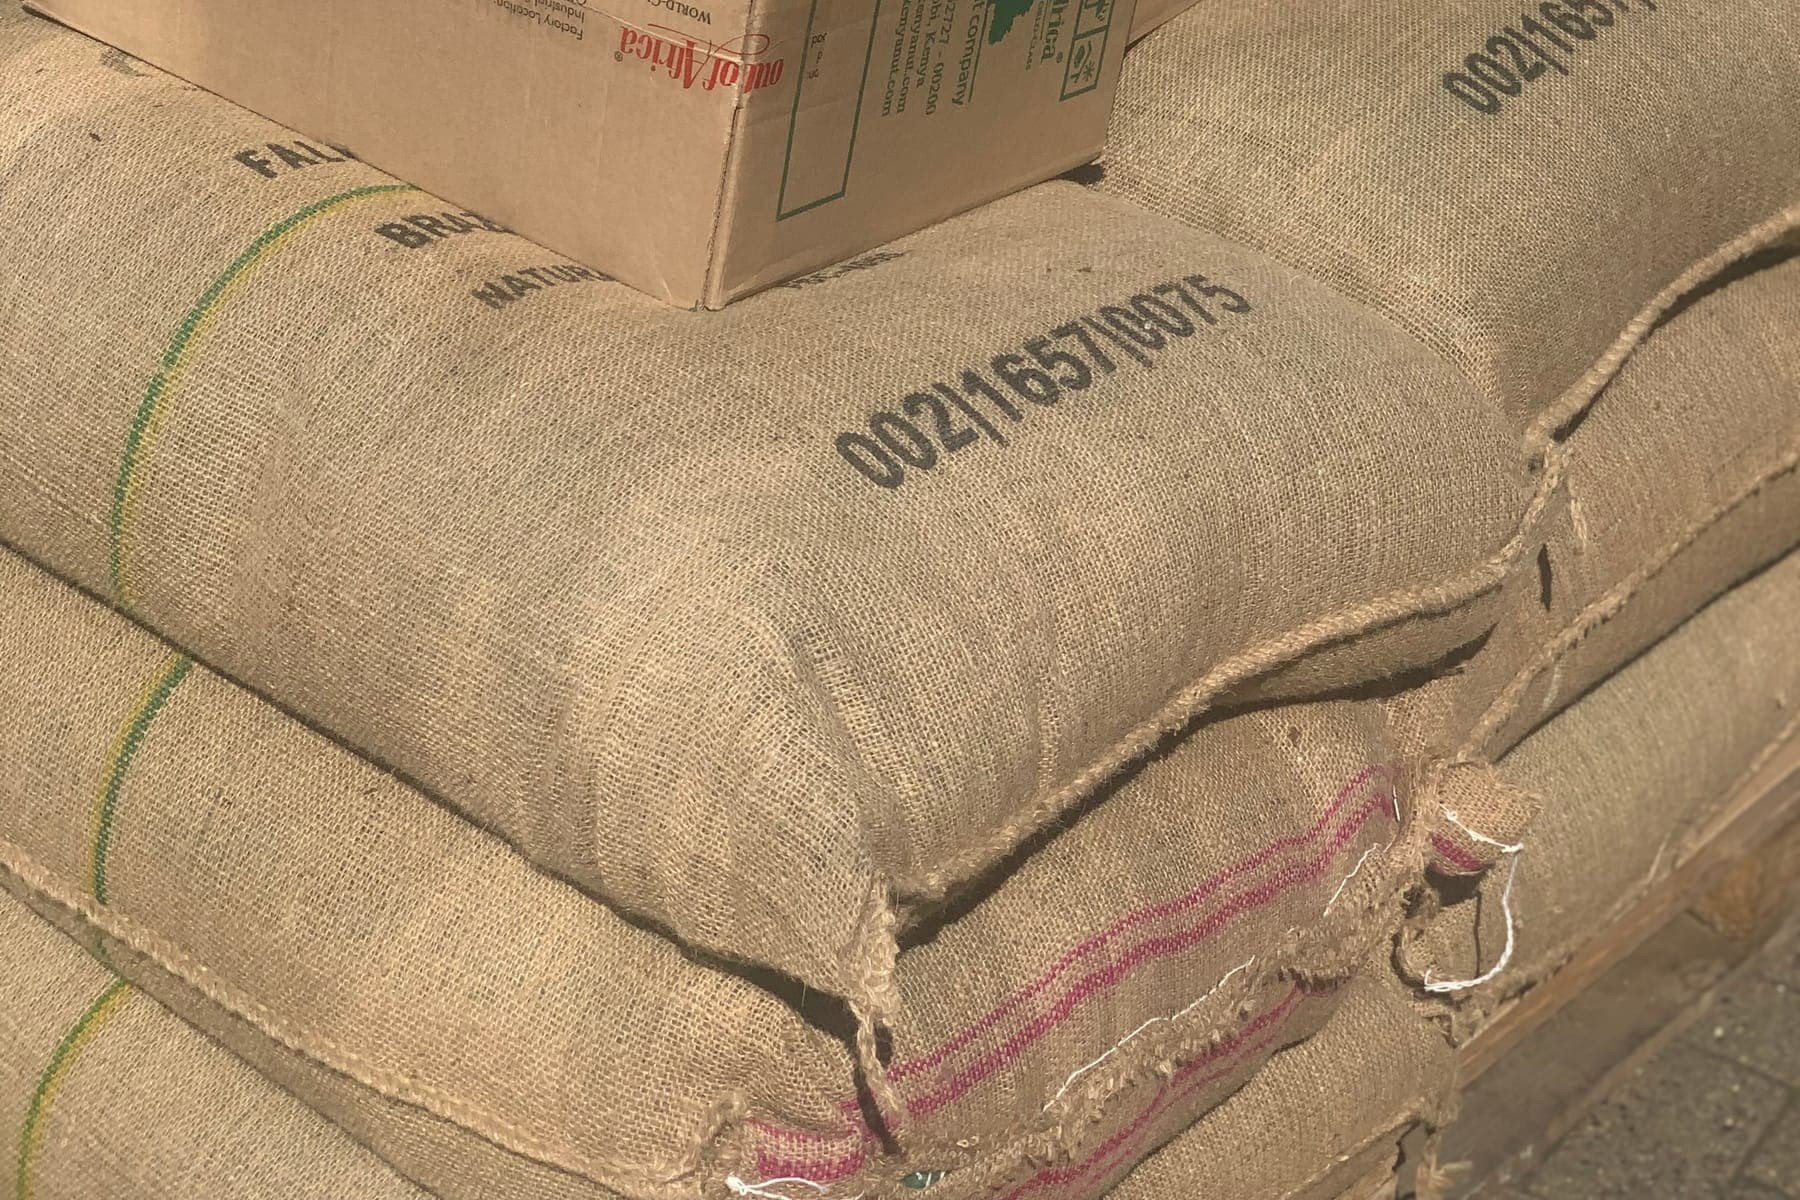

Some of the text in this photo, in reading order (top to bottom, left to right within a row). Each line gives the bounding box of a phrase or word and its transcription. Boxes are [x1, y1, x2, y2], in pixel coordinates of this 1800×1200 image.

[543, 12, 584, 41] Factory
[702, 58, 741, 92] of
[742, 56, 785, 94] out
[915, 30, 937, 88] Kenya
[951, 14, 983, 107] company
[924, 63, 945, 116] 00200
[233, 138, 357, 179] FAL
